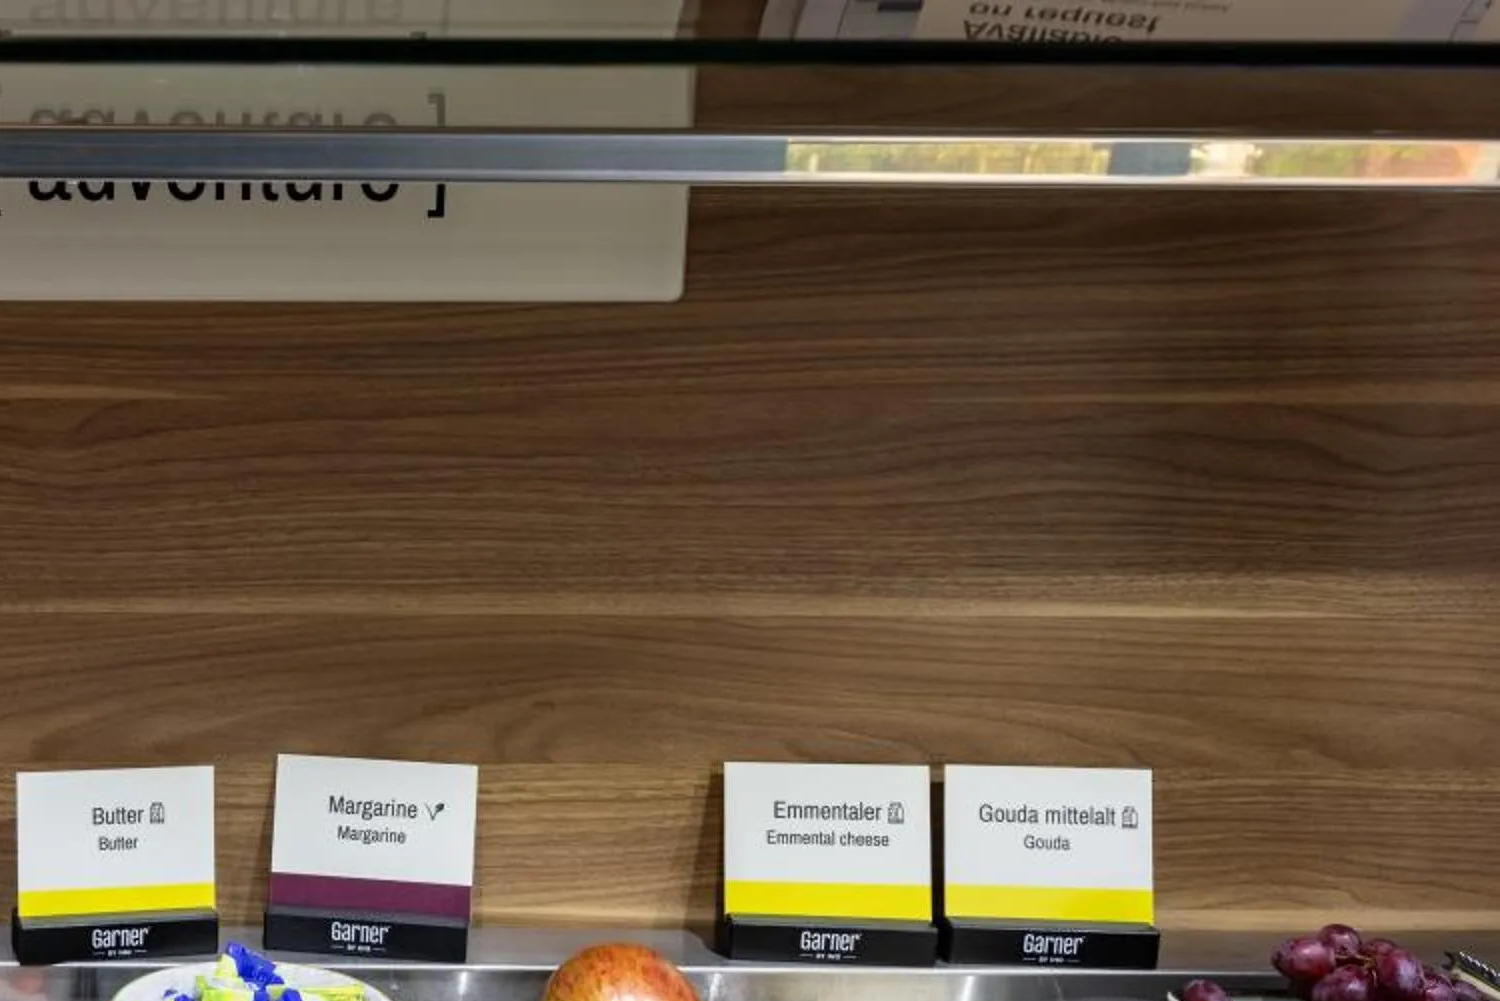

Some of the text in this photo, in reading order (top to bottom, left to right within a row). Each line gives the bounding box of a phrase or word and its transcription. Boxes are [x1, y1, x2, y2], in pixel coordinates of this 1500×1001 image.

[92, 807, 144, 826] Butter
[328, 795, 418, 821] Margarine
[773, 800, 883, 822] Emmentaler
[979, 803, 1116, 826] Gouda mittelalt
[99, 836, 139, 851] Butter
[337, 825, 407, 845] Margarine
[766, 829, 890, 847] Emmental cheese
[1023, 834, 1071, 851] Gouda
[91, 927, 150, 949] Garner
[331, 921, 390, 944] Garner
[800, 930, 861, 951] Garner
[1023, 933, 1085, 956] Garner
